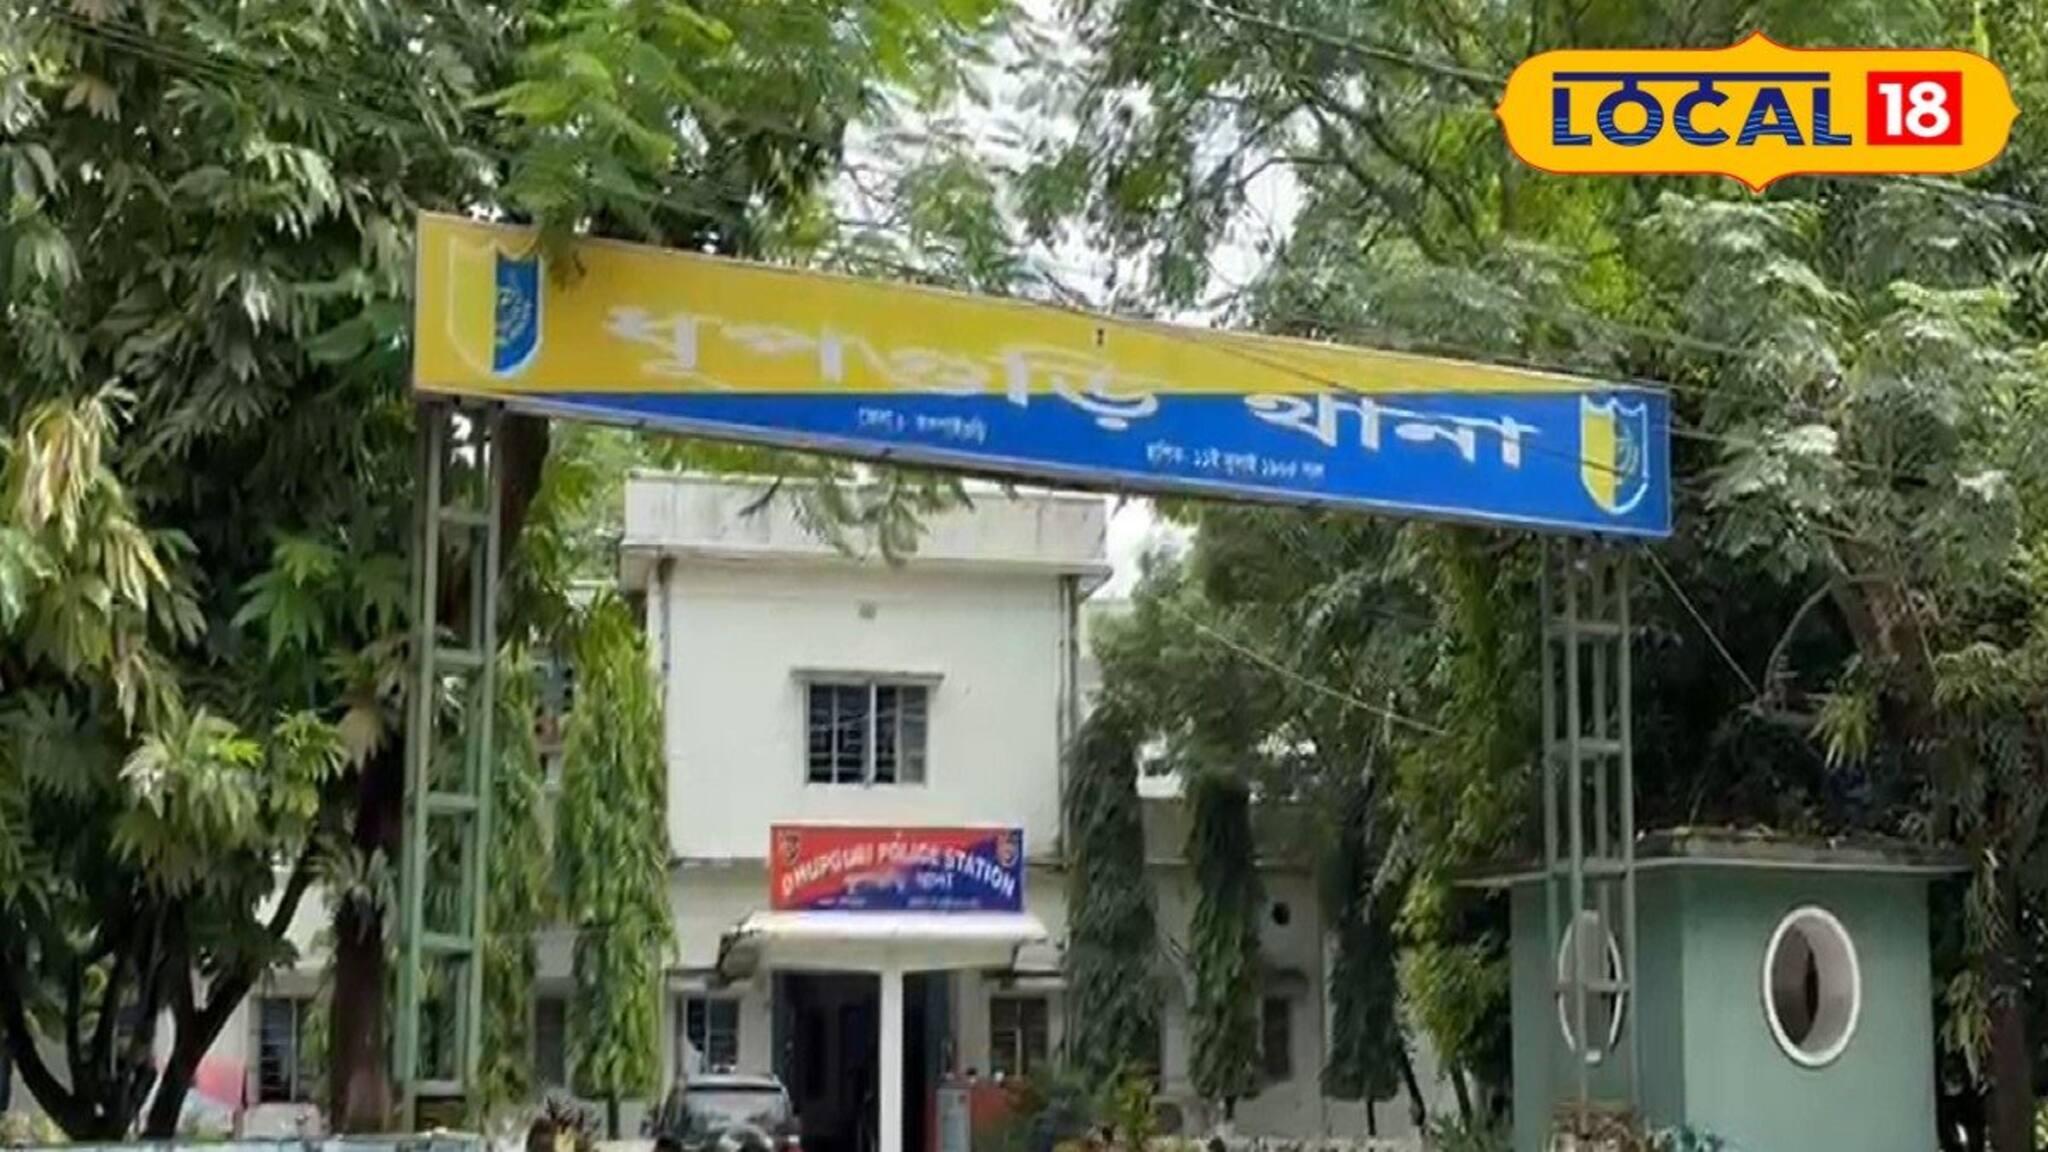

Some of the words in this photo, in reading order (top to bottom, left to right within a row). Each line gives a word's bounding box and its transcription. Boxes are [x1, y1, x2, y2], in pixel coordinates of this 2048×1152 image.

[1243, 392, 1542, 468] থানা
[878, 842, 940, 866] POLICE
[944, 847, 1016, 897] STATION
